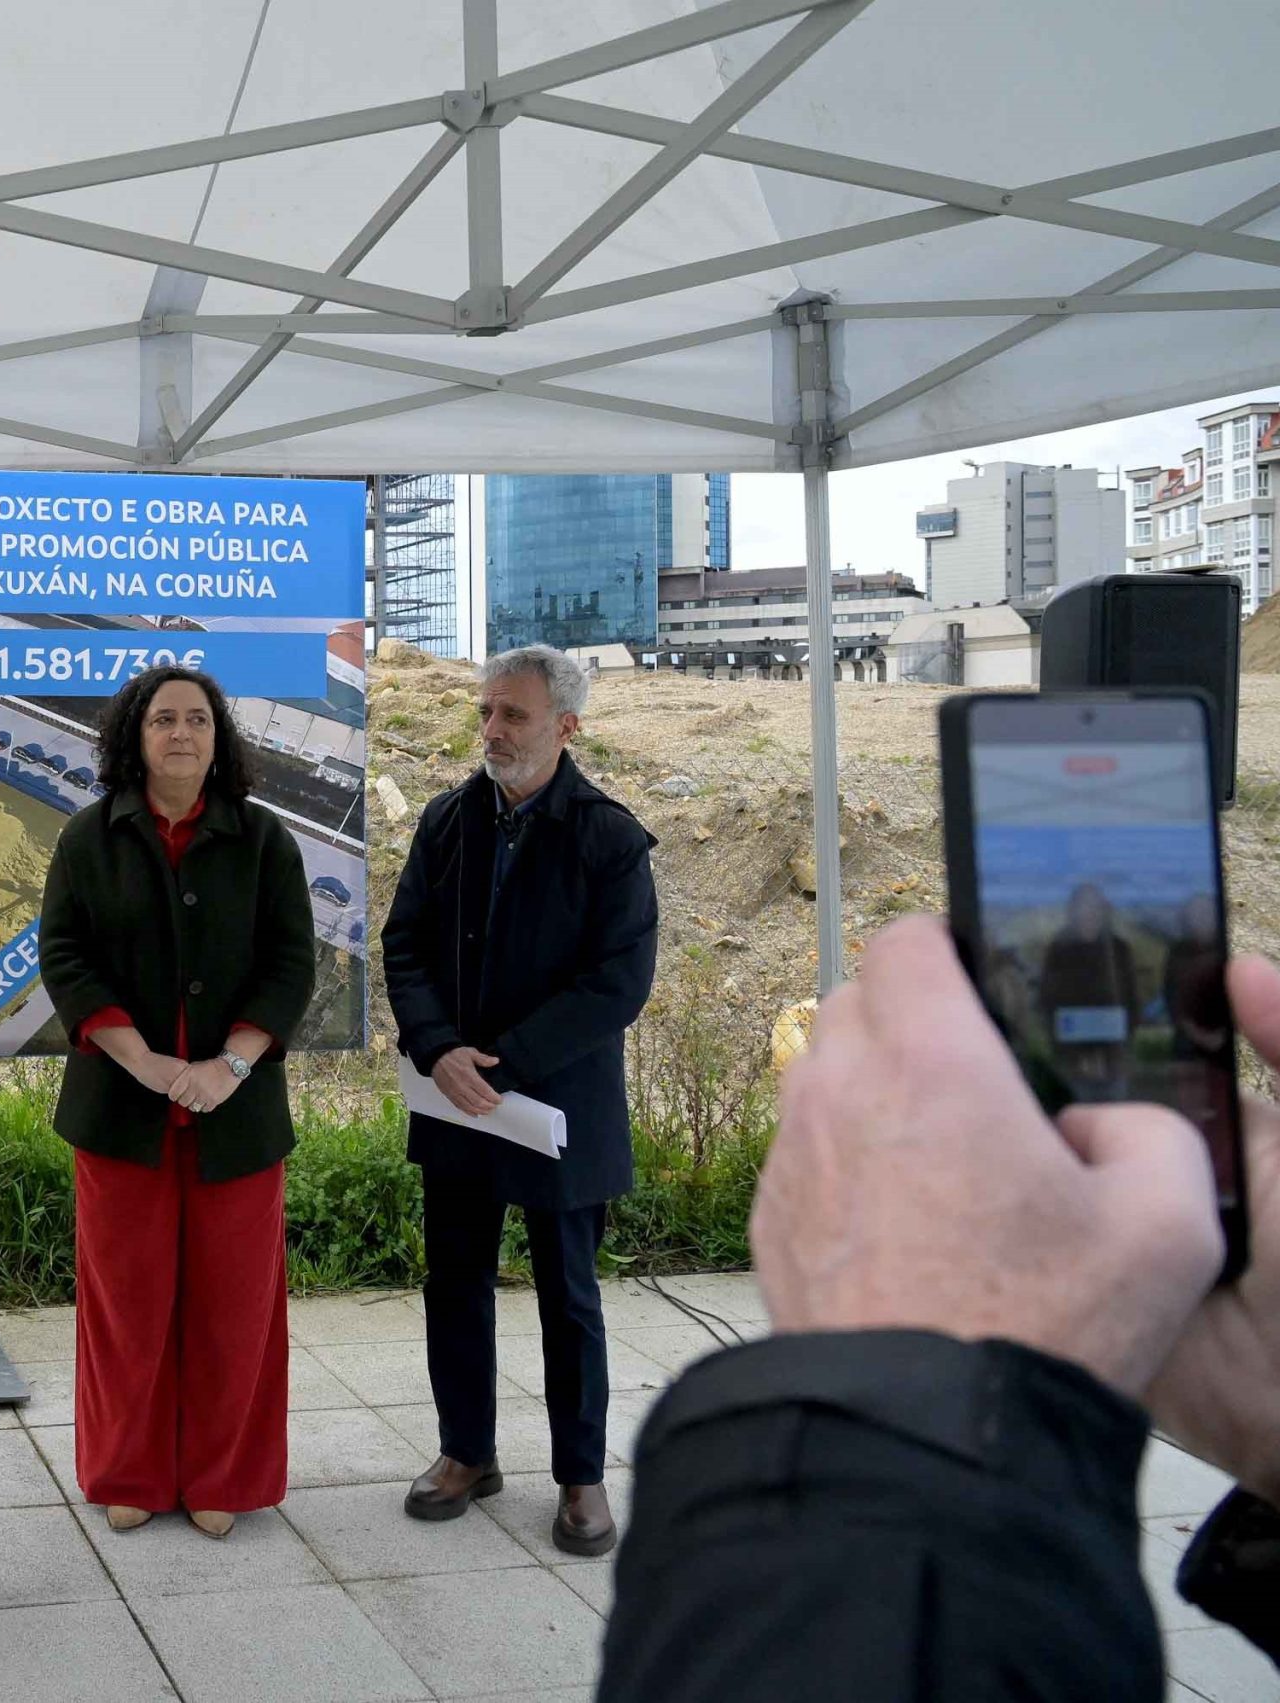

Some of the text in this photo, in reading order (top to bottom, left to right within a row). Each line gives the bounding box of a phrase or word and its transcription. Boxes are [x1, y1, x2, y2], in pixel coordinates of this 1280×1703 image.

[122, 499, 138, 523] E
[145, 499, 226, 525] OBRA
[234, 502, 308, 527] PARA
[1, 528, 179, 561] PROMOCIÓN
[189, 530, 309, 563] PÚBLICA
[106, 572, 148, 597] NA
[155, 568, 277, 599] CORUÑA
